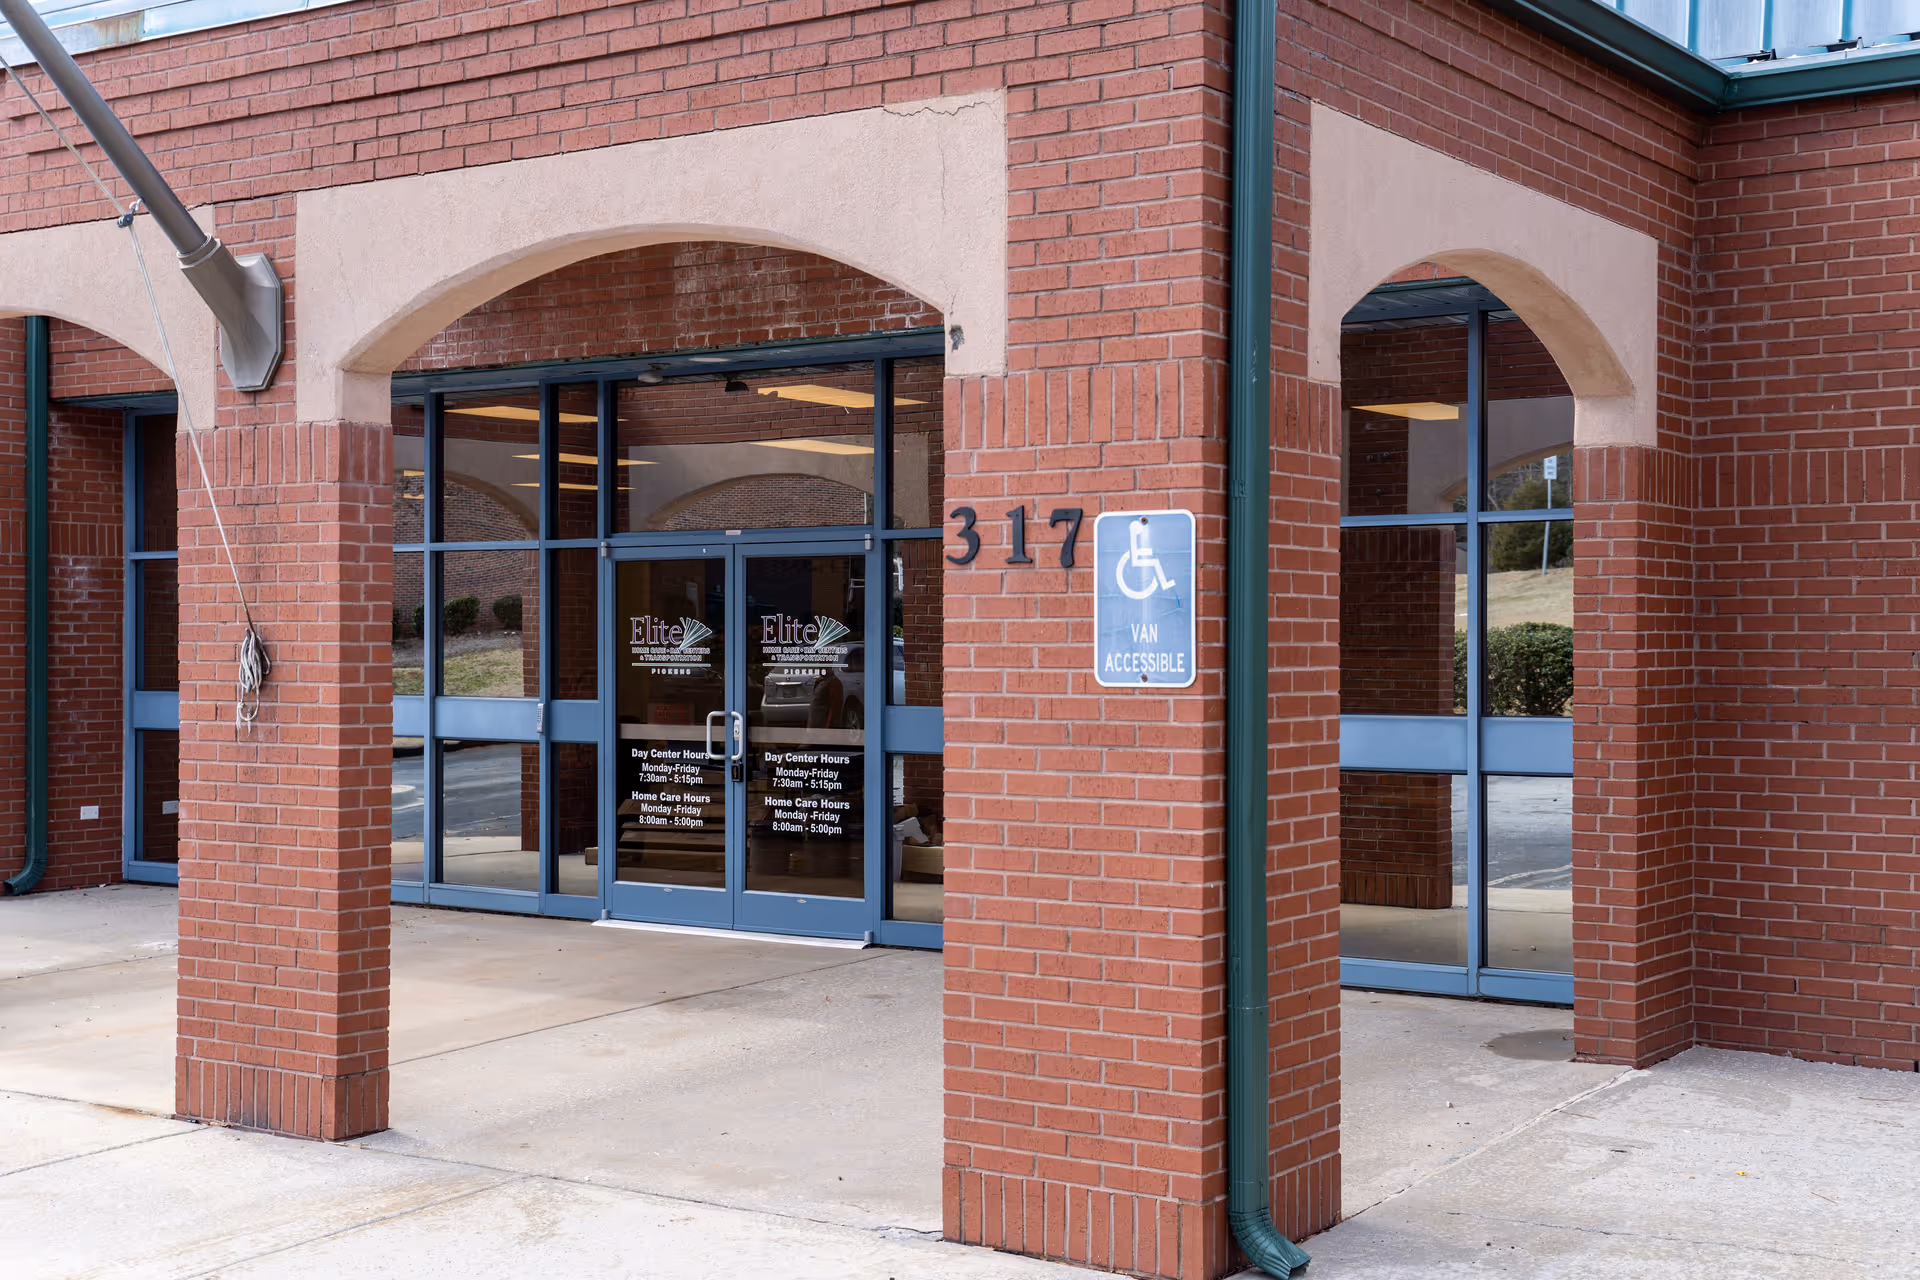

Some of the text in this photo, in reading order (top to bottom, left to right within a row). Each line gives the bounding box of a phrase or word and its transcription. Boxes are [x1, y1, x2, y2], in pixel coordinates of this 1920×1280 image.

[946, 505, 1083, 568] 317
[630, 615, 683, 645] Elite
[760, 613, 818, 645] Elite
[1130, 623, 1158, 643] VAN
[1105, 653, 1185, 673] ACCESSIBLE
[631, 748, 710, 760] Day Center Hours
[764, 752, 850, 764] Day Center Hours
[641, 762, 701, 775] Monday-Friday
[775, 767, 839, 780] Monday-Friday
[639, 773, 667, 783] 7:30am
[674, 774, 703, 785] 5:15pm
[772, 778, 803, 788] 7:30am
[810, 779, 842, 791] 5:15pm
[631, 791, 711, 803] Home Care Hours
[764, 796, 850, 810] Home Care Hours
[641, 803, 672, 815] Monday
[774, 809, 808, 822] Monday
[639, 815, 667, 825] 8:00am
[674, 817, 703, 828] 5:00pm
[772, 822, 803, 832] 8:00am
[810, 824, 842, 835] 5:00pm
